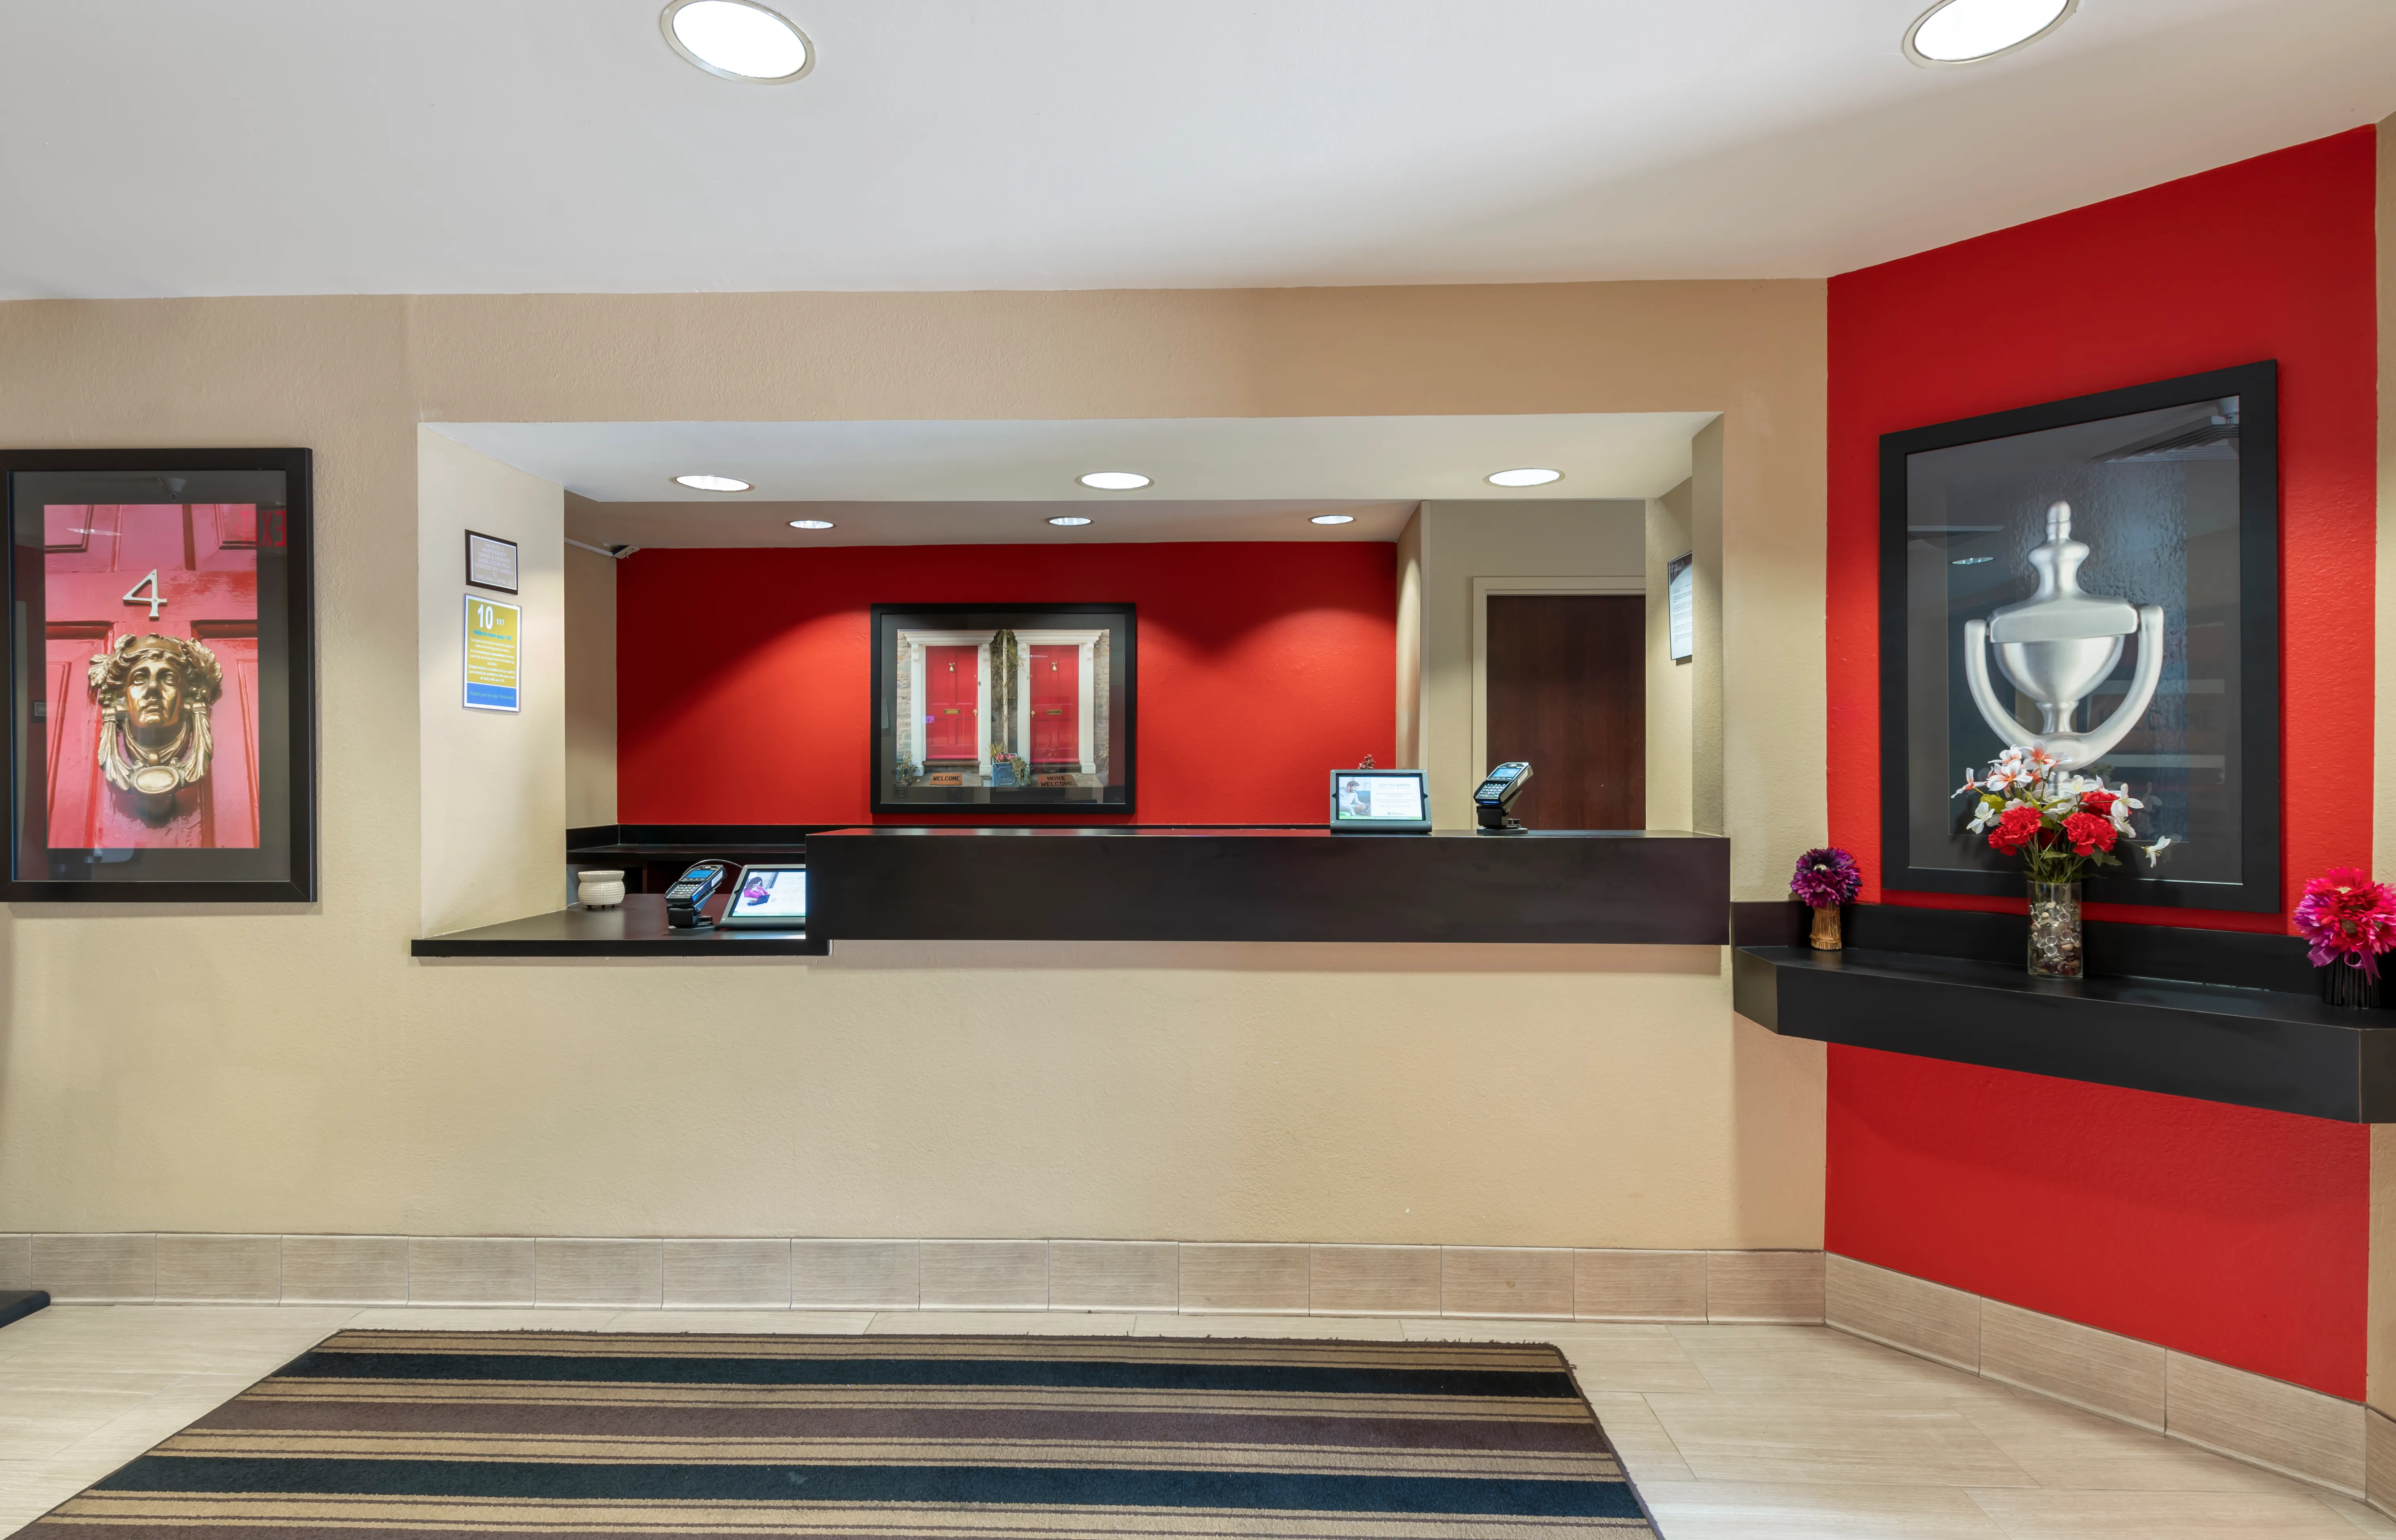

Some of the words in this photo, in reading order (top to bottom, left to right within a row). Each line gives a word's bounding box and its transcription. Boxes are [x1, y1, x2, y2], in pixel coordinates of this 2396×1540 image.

[482, 547, 506, 557] INDEPENDENTLY
[122, 569, 167, 618] 4
[477, 604, 493, 630] 10
